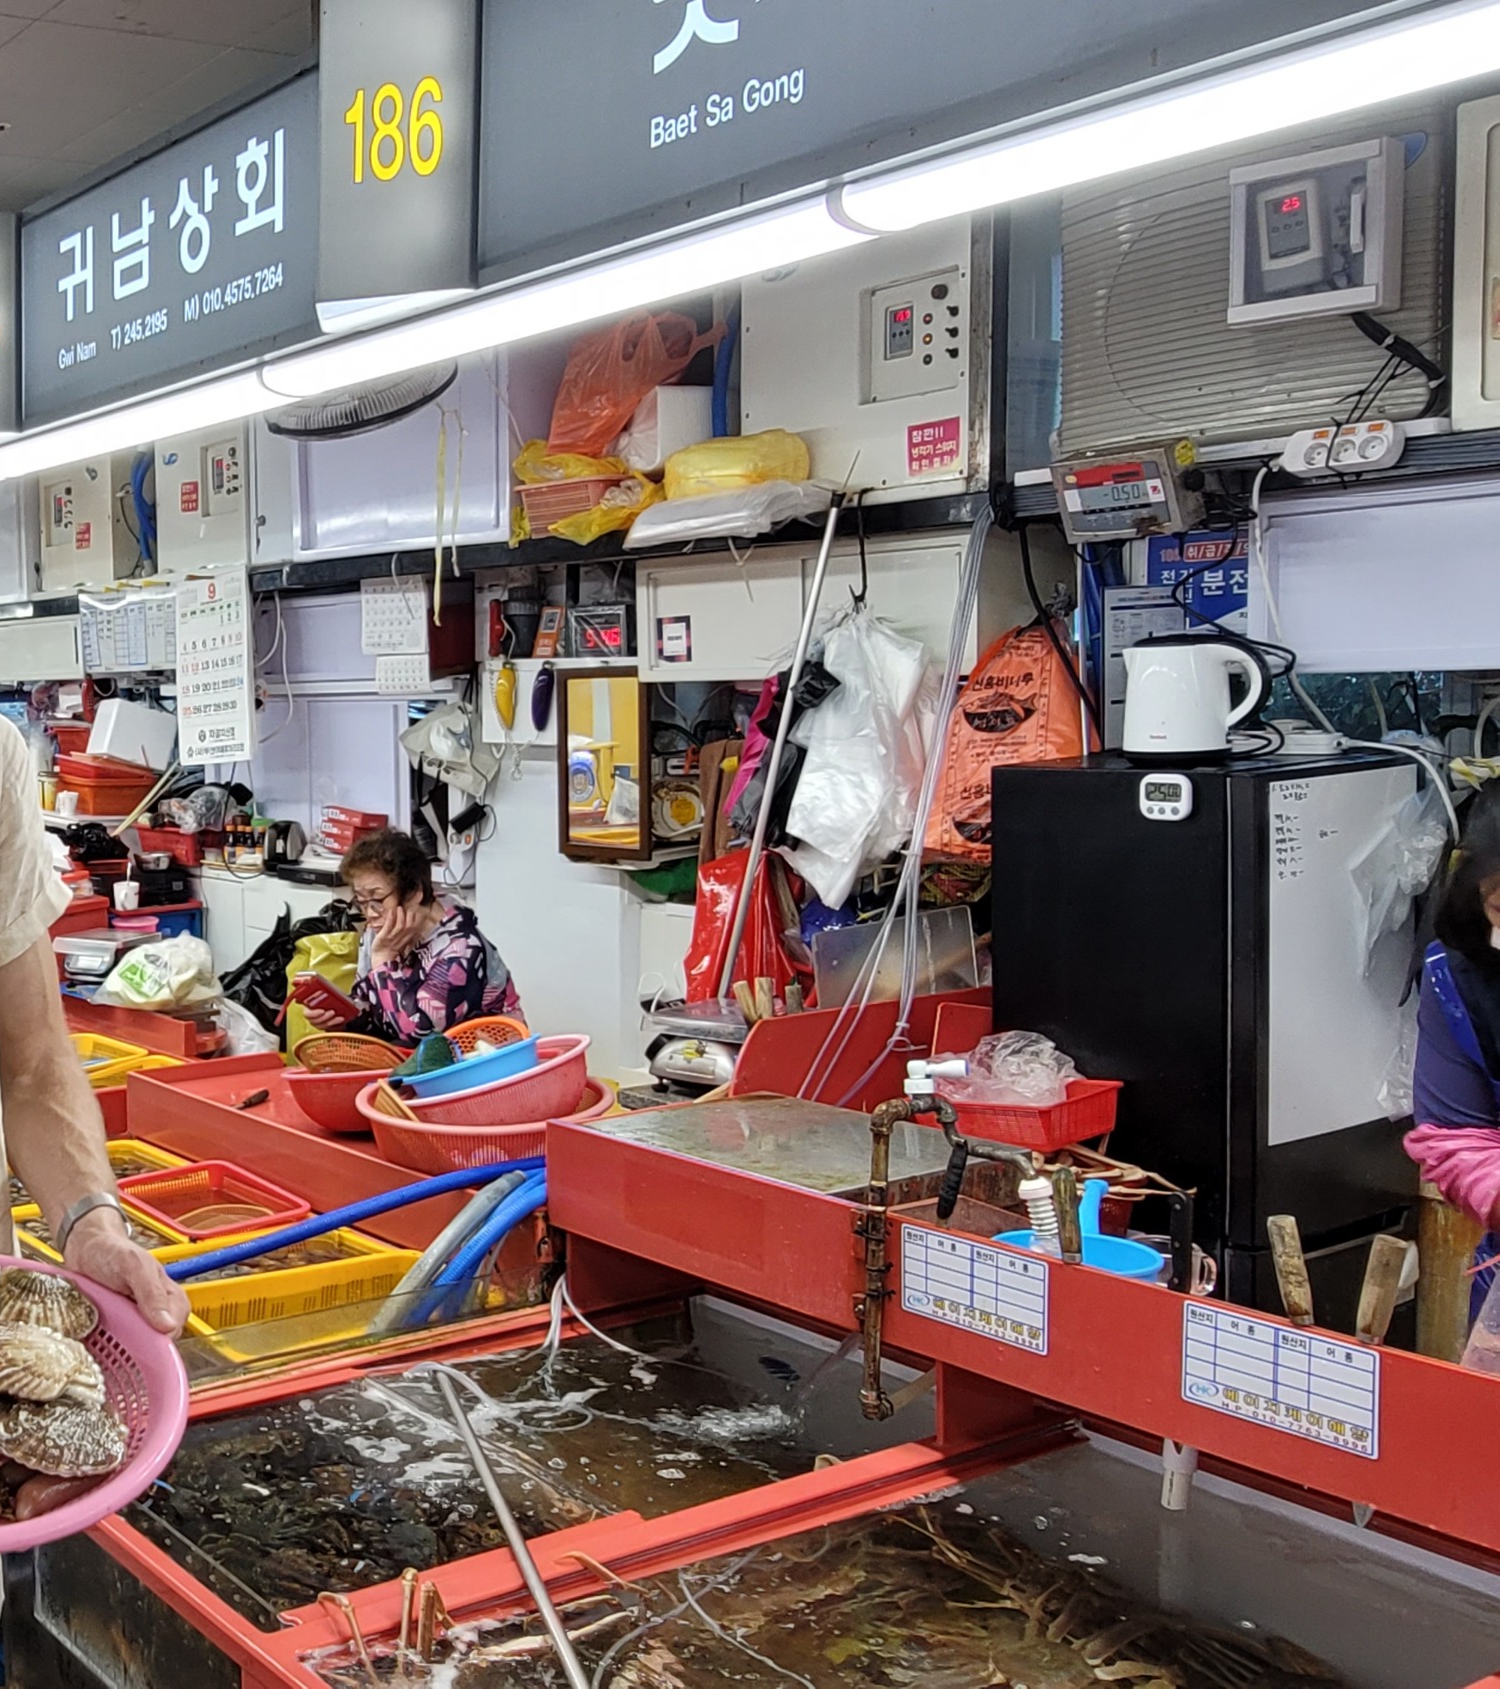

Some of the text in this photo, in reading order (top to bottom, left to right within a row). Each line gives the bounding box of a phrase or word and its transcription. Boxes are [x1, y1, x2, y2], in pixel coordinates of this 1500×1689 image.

[344, 76, 444, 185] 186
[650, 67, 805, 149] Baet Sa Gong
[57, 127, 287, 323] 귀남상회
[58, 347, 74, 370] Gwi
[76, 341, 97, 362] Nam
[202, 261, 284, 315] 010.4575.7264
[207, 582, 216, 600] 9
[1190, 1309, 1214, 1324] 원산지
[1281, 1335, 1307, 1350] 원산지
